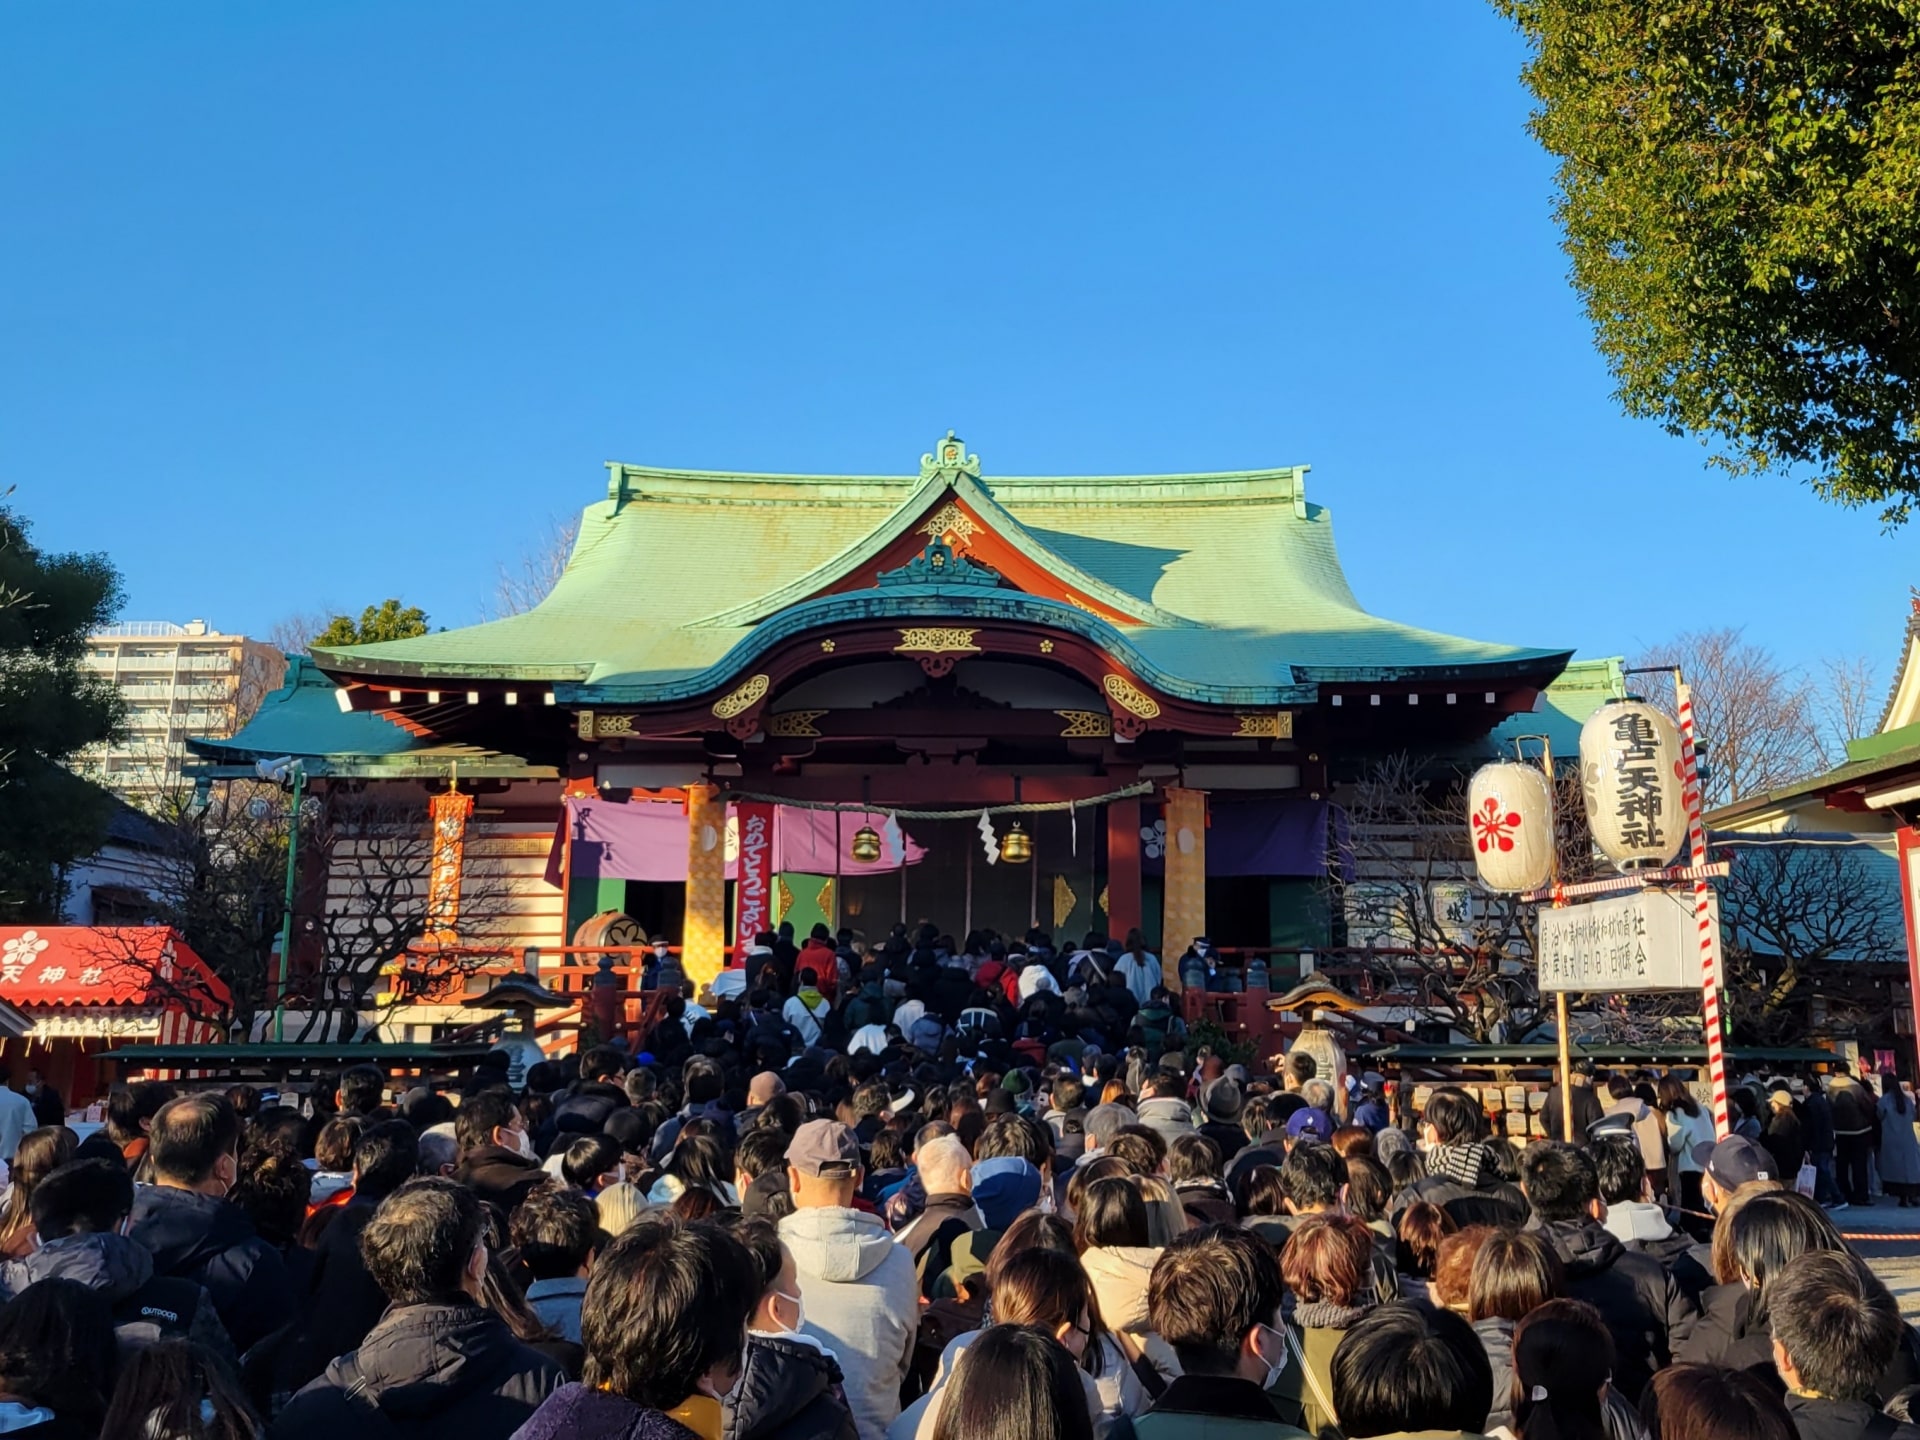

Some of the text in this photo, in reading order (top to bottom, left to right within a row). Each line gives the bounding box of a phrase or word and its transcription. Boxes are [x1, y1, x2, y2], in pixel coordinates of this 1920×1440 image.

[1609, 713, 1665, 849] 亀戸天神社
